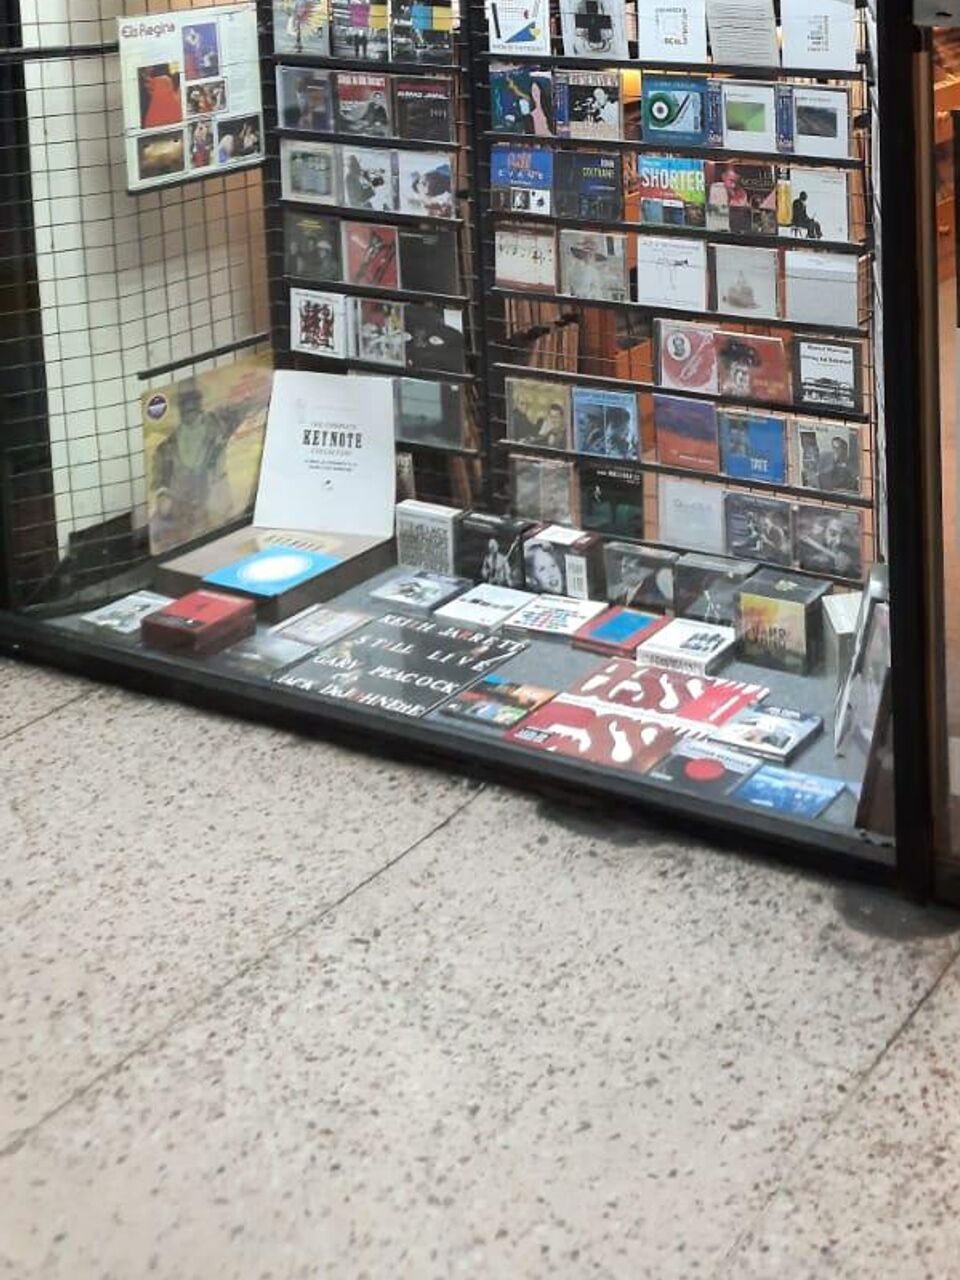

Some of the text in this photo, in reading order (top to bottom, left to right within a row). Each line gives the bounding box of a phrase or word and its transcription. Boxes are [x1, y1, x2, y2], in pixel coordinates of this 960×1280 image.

[640, 166, 705, 190] SHORTER
[302, 428, 362, 449] KEYNOTE
[382, 613, 527, 653] KEITH JARRETT
[354, 634, 492, 671] STILL LIVE
[369, 664, 462, 694] PEACOCK
